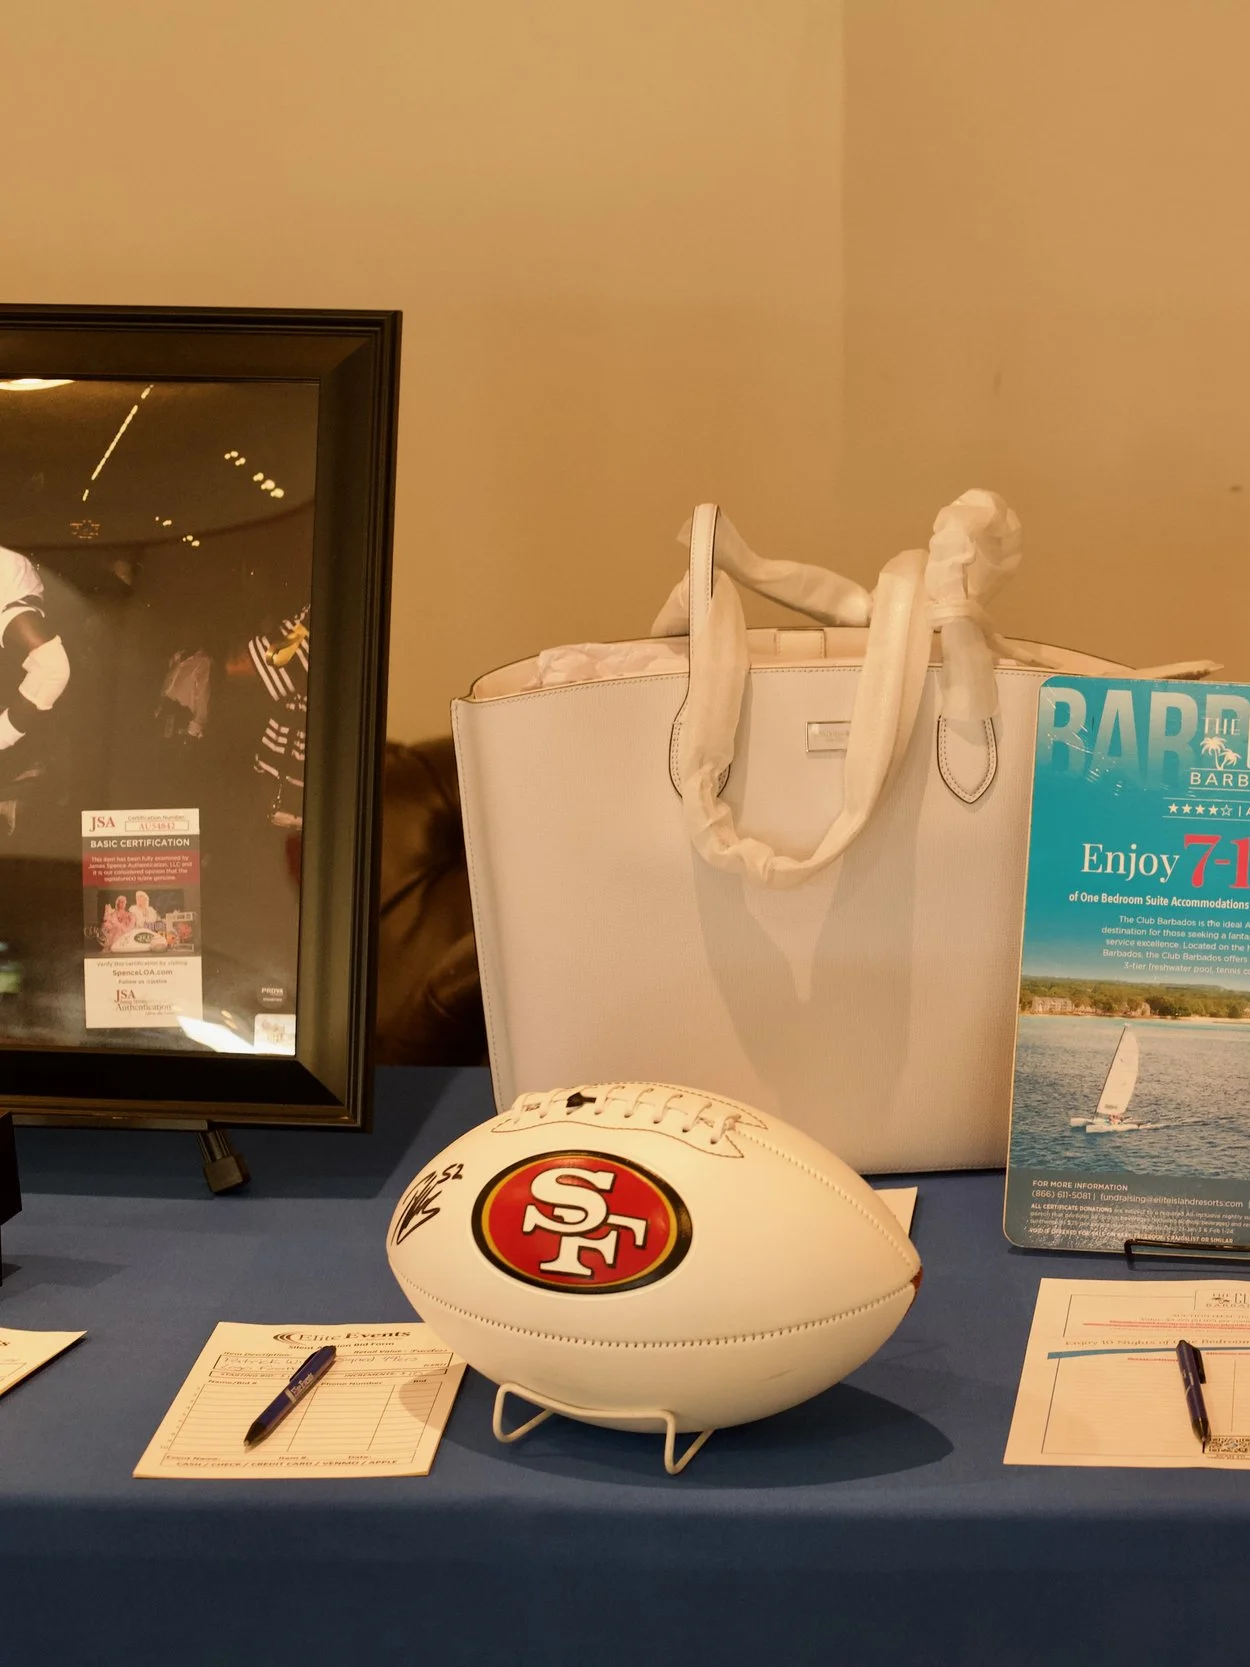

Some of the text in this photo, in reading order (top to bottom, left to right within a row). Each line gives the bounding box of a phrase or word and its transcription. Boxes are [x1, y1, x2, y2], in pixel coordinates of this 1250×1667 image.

[1202, 718, 1240, 736] THE
[90, 816, 115, 832] JSA
[90, 839, 190, 848] BASIC CERTIFICATION
[1080, 843, 1180, 884] Enjoy
[1068, 891, 1080, 902] of
[1080, 891, 1098, 902] One
[1101, 892, 1143, 904] Bedroom
[1146, 894, 1168, 906] Suite
[1170, 896, 1249, 909] Accommodations
[1119, 915, 1134, 923] The
[1136, 916, 1154, 924] Club
[1157, 917, 1196, 926] Barbados
[1207, 919, 1220, 927] the
[1222, 920, 1242, 928] ideal
[1101, 926, 1146, 936] destination
[1148, 928, 1160, 936] for
[1162, 929, 1186, 938] those
[1188, 931, 1219, 941] seeking
[1106, 939, 1134, 947] service
[1182, 941, 1216, 950] Located
[1231, 944, 1244, 952] the
[1146, 951, 1159, 959] the
[1161, 951, 1180, 960] Club
[1182, 952, 1221, 962] Barbados
[1223, 954, 1248, 963] offers
[1124, 962, 1146, 970] 3-tier
[1148, 963, 1191, 972] freshwater
[1216, 966, 1240, 974] tennis
[114, 989, 136, 1003] JSA
[115, 1003, 172, 1012] Authentication
[437, 1163, 464, 1184] 52
[1075, 1182, 1128, 1191] INFORMATION
[1032, 1190, 1055, 1198] (866)
